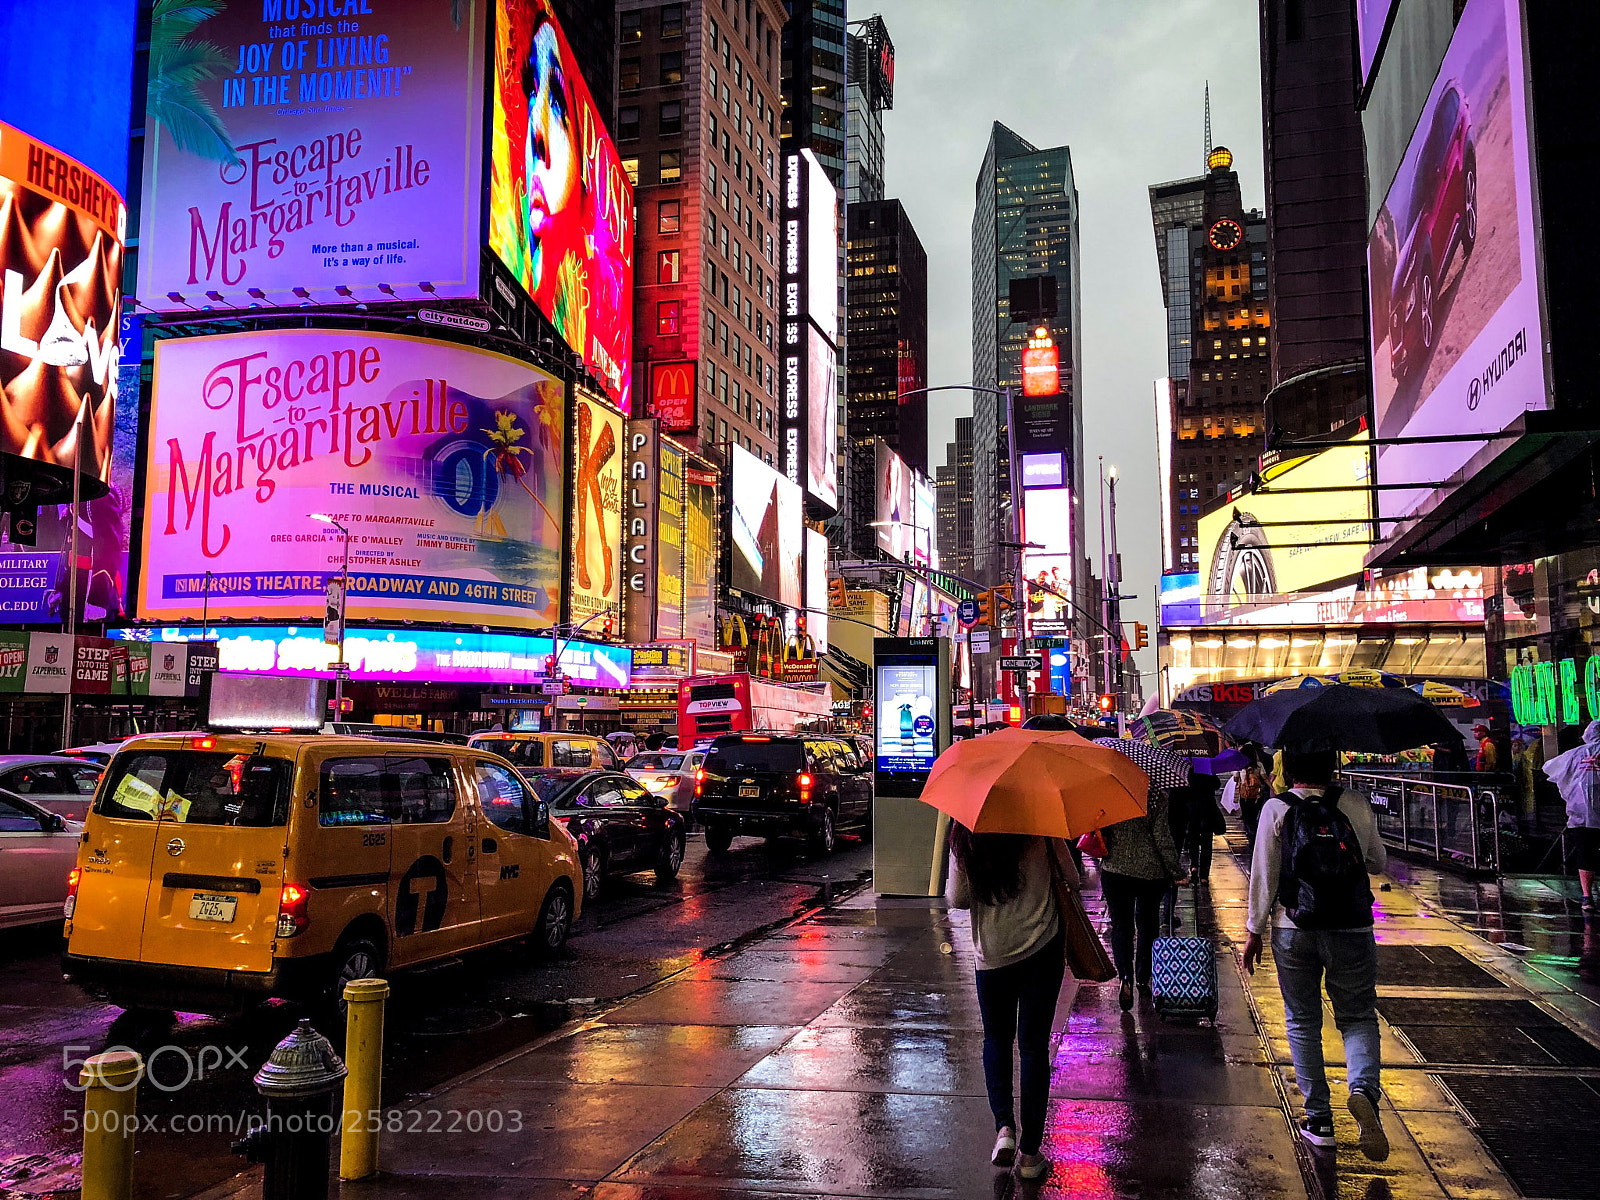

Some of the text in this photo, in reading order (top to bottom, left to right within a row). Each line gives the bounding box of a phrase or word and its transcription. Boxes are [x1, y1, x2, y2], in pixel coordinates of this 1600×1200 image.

[262, 0, 372, 22] MUSICAL
[269, 20, 359, 38] that finds the
[234, 34, 388, 74] JOY OF LIVING
[222, 78, 245, 108] IN
[252, 75, 290, 106] THE
[220, 128, 362, 212] Escape
[27, 143, 118, 232] HERSHEY'S
[582, 100, 631, 268] POSE
[787, 155, 798, 209] EXPRESS
[187, 144, 430, 285] Margaritaville
[312, 239, 420, 254] More than a musical.
[786, 220, 798, 274] EXPRESS
[324, 253, 407, 268] It's a way of life.
[425, 310, 485, 328] city outdoor
[1482, 327, 1528, 395] HYUNDAI
[202, 346, 380, 444] Escape
[786, 356, 798, 419] EXPRESS
[660, 398, 688, 406] OPEN
[1024, 404, 1058, 412] LANDMARK
[662, 406, 684, 418] 24
[164, 378, 468, 558] Margaritaville
[330, 482, 420, 498] THE MUSICAL
[352, 514, 434, 526] TO MARGARITAVILLE
[631, 433, 648, 593] PALACE
[270, 535, 292, 543] GREG
[295, 535, 326, 543] GARCIA
[337, 535, 358, 543] MKE
[362, 536, 403, 546] O'MALLEY
[416, 540, 476, 552] JIMMY BUFFETT
[1288, 548, 1302, 558] SAFE
[1342, 524, 1360, 538] SAFE
[0, 559, 49, 569] MILITARY
[327, 556, 422, 567] CHRSTOPHER ASHLEY
[188, 574, 252, 594] MARQUIS
[256, 576, 326, 594] THEATRE,
[429, 580, 460, 597] AND
[464, 583, 498, 601] 46TH
[502, 586, 538, 605] STREET
[4, 650, 25, 664] OPEN!
[78, 647, 109, 660] STEP
[78, 661, 94, 669] INTO
[116, 663, 126, 675] NO
[190, 656, 216, 667] STEP
[32, 666, 67, 675] EXPERIENCE
[76, 669, 108, 681] GAME
[155, 673, 181, 681] EXPERIENCE
[189, 675, 201, 684] GA
[376, 687, 457, 700] WELLS FARGO
[1172, 682, 1253, 702] tkts tkts
[252, 743, 267, 755] 31
[1370, 791, 1388, 809] Subway
[363, 833, 386, 846] 2G25
[500, 865, 520, 880] NYC
